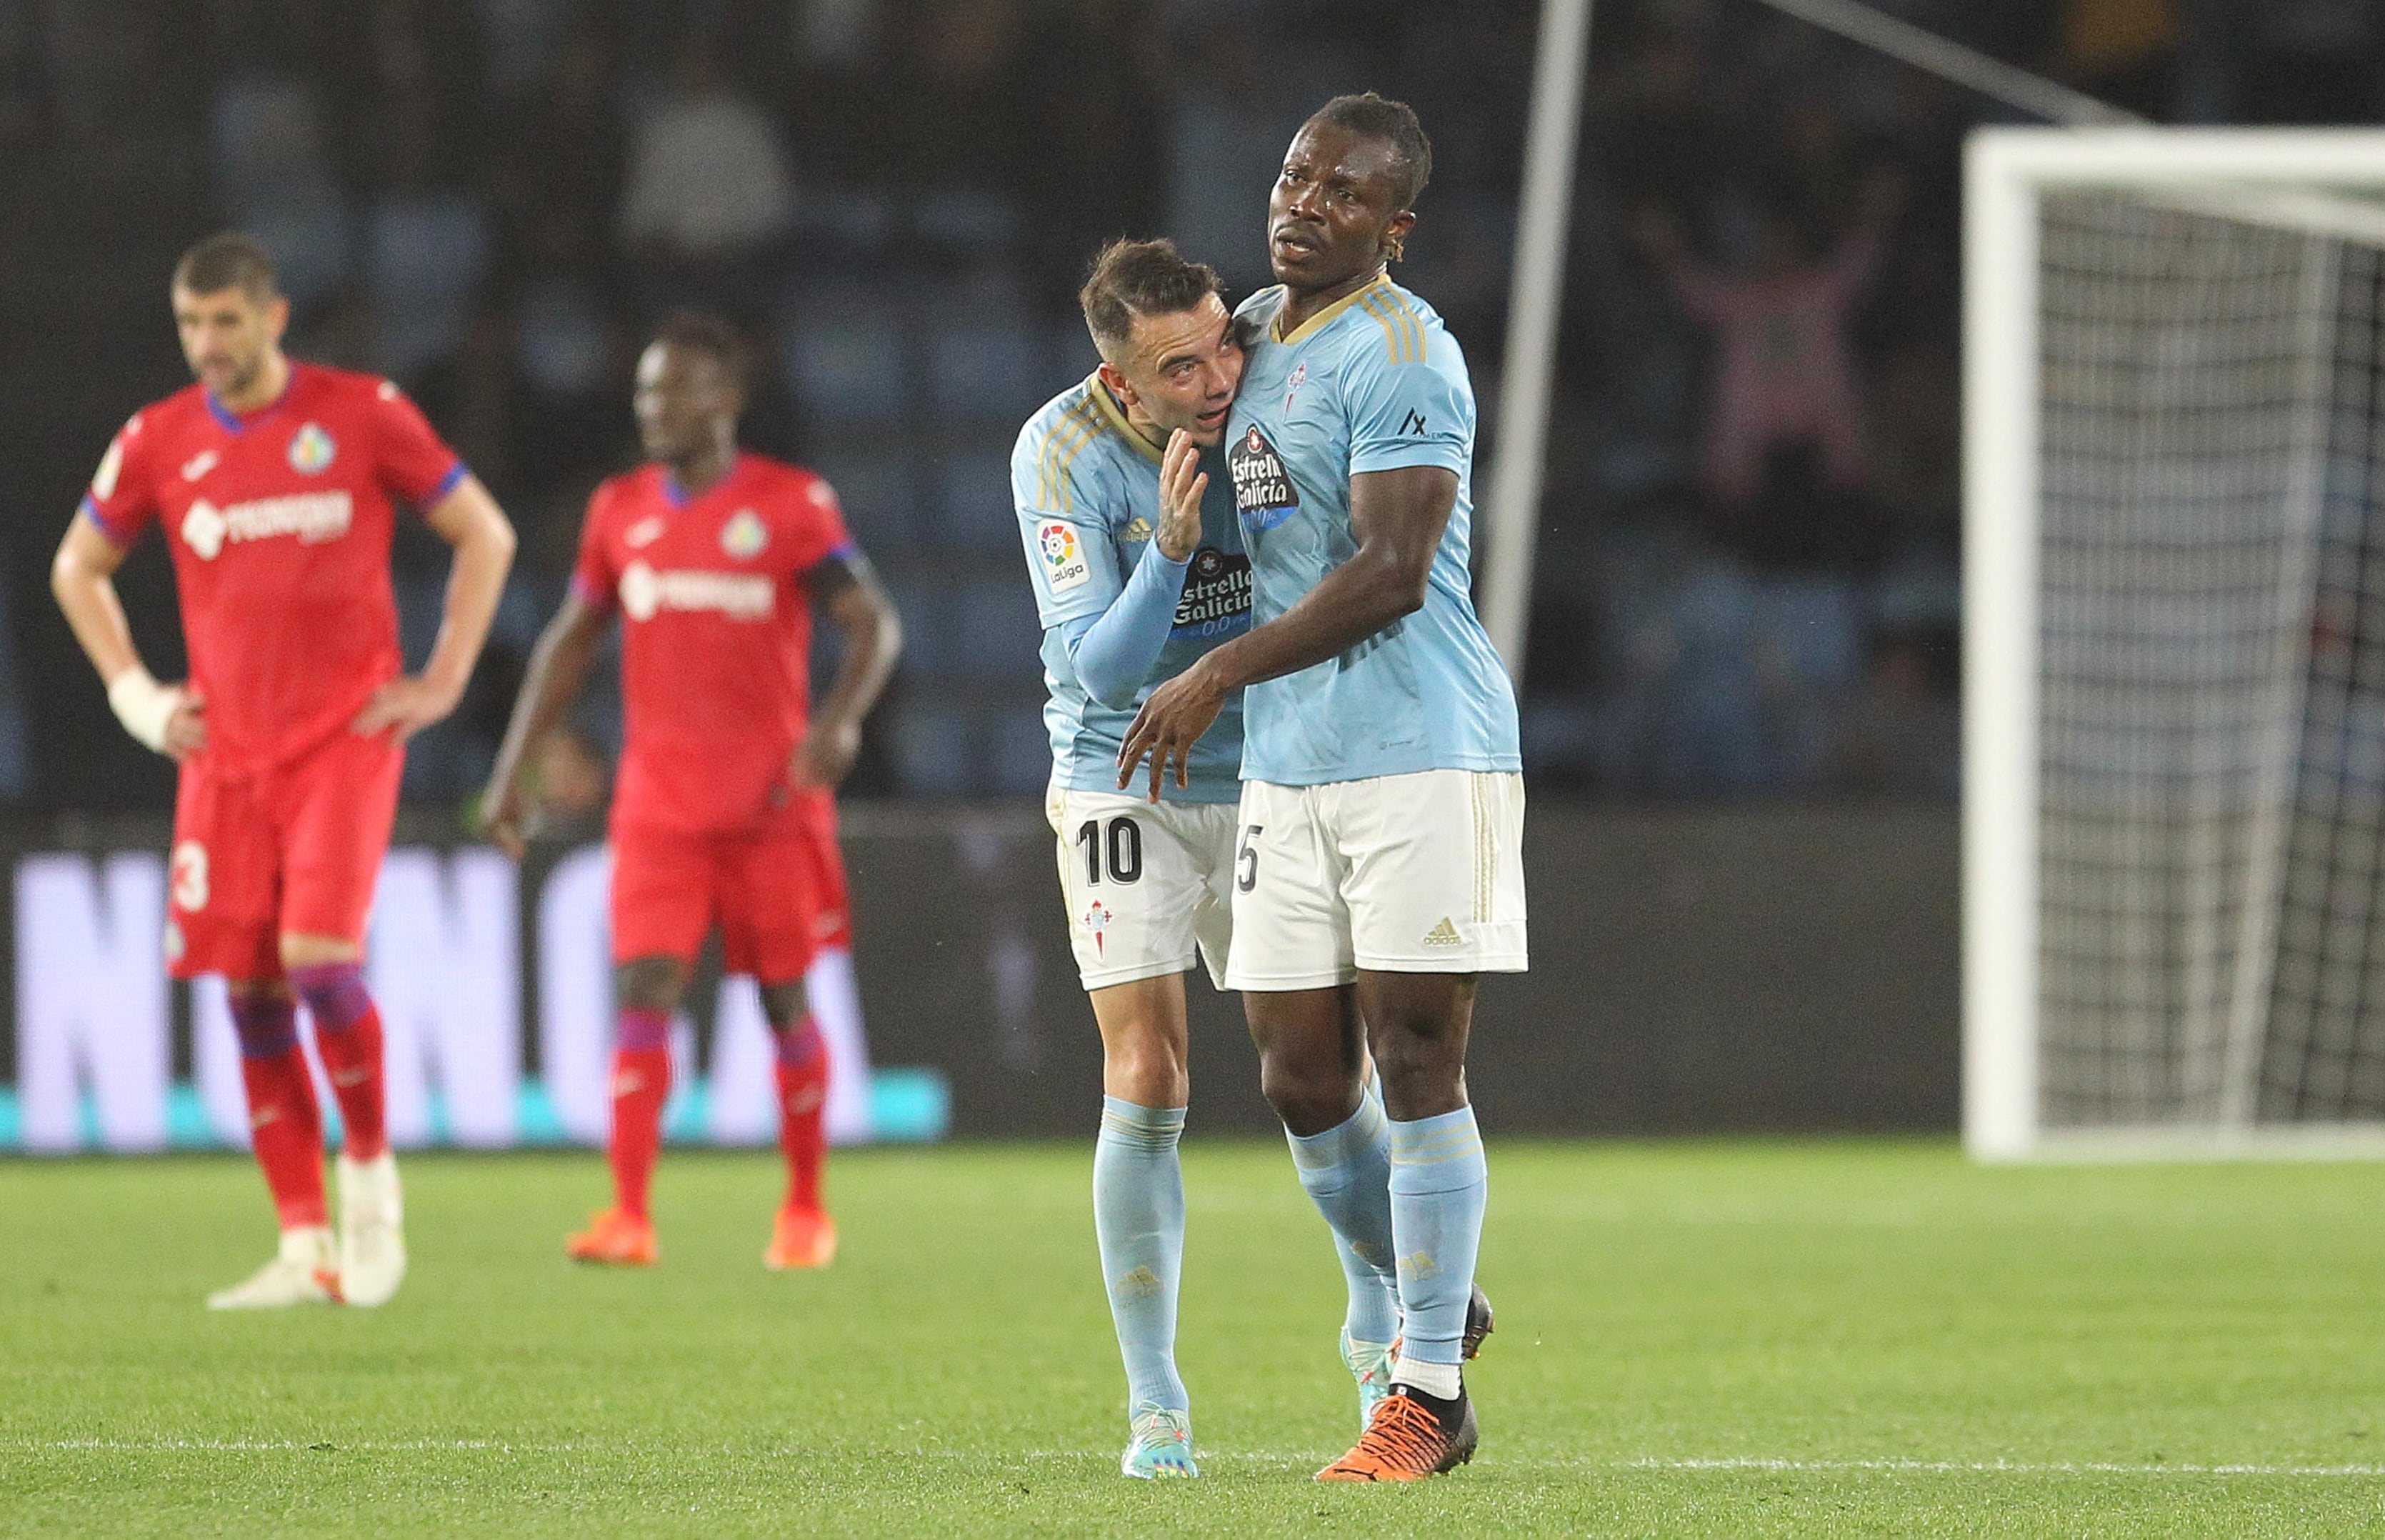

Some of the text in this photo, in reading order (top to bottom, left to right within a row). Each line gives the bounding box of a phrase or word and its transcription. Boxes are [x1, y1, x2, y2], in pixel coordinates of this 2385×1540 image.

[1236, 479, 1287, 509] Galicia
[1051, 564, 1084, 584] LaLiga
[1177, 569, 1252, 605] strella
[1076, 816, 1143, 887] 10
